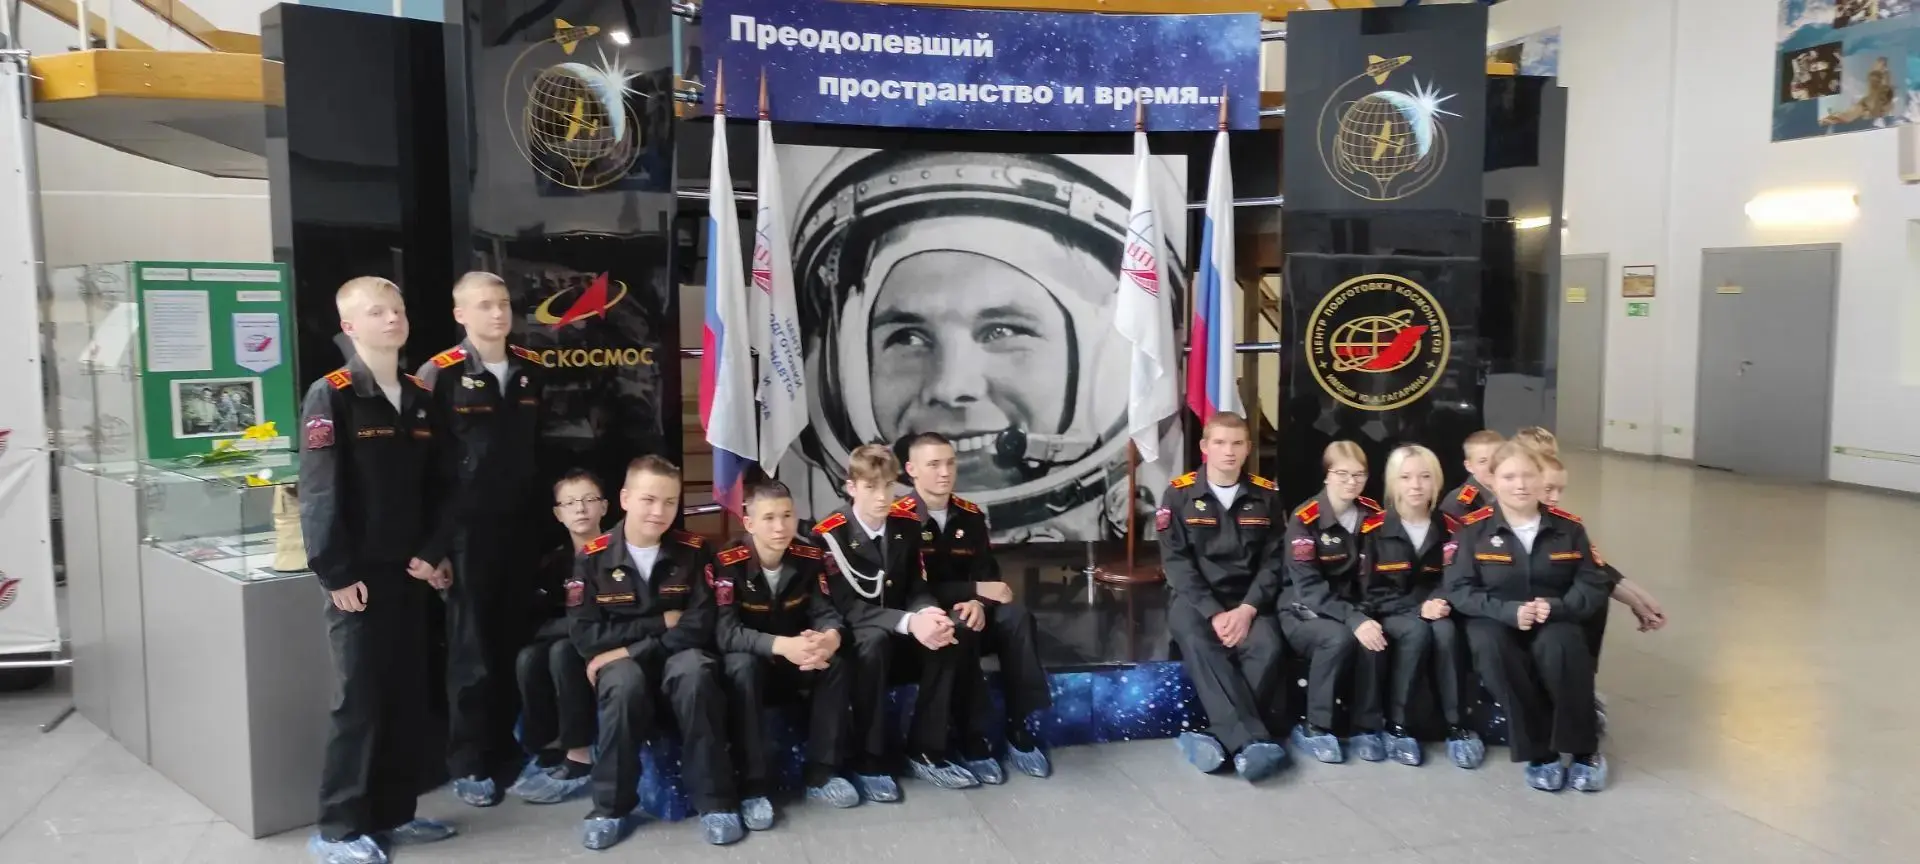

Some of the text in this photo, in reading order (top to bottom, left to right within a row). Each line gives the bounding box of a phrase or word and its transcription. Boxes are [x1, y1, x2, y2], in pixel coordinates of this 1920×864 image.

[730, 14, 994, 58] Преодолевший
[819, 76, 1054, 106] пространство
[1063, 86, 1085, 105] и
[1314, 282, 1443, 354] ЦЕНТР ПОДГОТОВКИ КОСМОНАВТОВ
[541, 347, 654, 368] СКОСМОС
[770, 312, 803, 388] ОДГОТОВКИ
